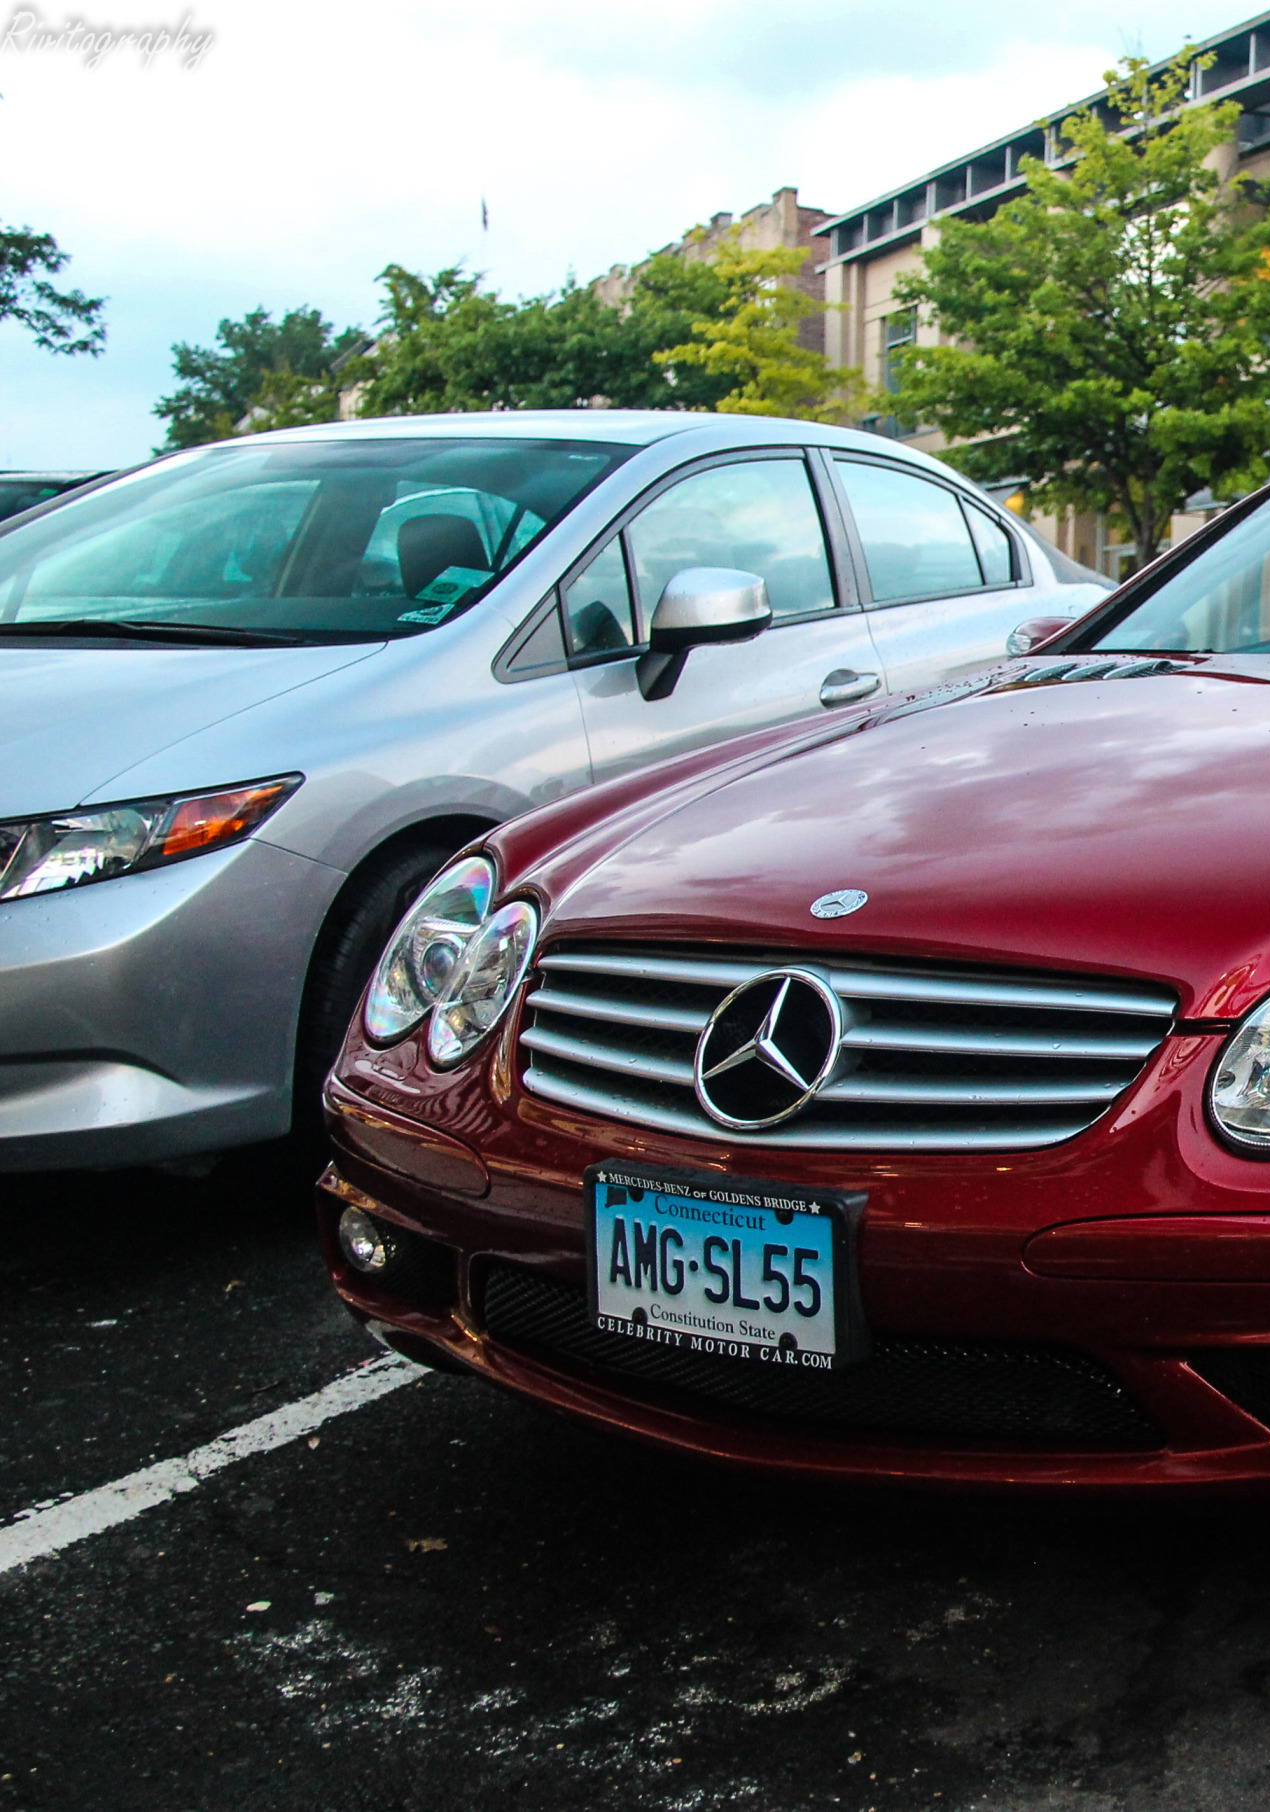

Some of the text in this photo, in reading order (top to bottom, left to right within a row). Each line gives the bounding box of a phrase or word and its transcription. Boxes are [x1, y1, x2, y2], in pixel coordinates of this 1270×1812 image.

[608, 1172, 807, 1212] MERCEDES-BENZ OF GOLDENS BRIDGE
[654, 1195, 766, 1231] Connecticut
[597, 1316, 682, 1346] CELEBRITY
[691, 1336, 750, 1358] MOTOR
[650, 1303, 776, 1340] Constitution State
